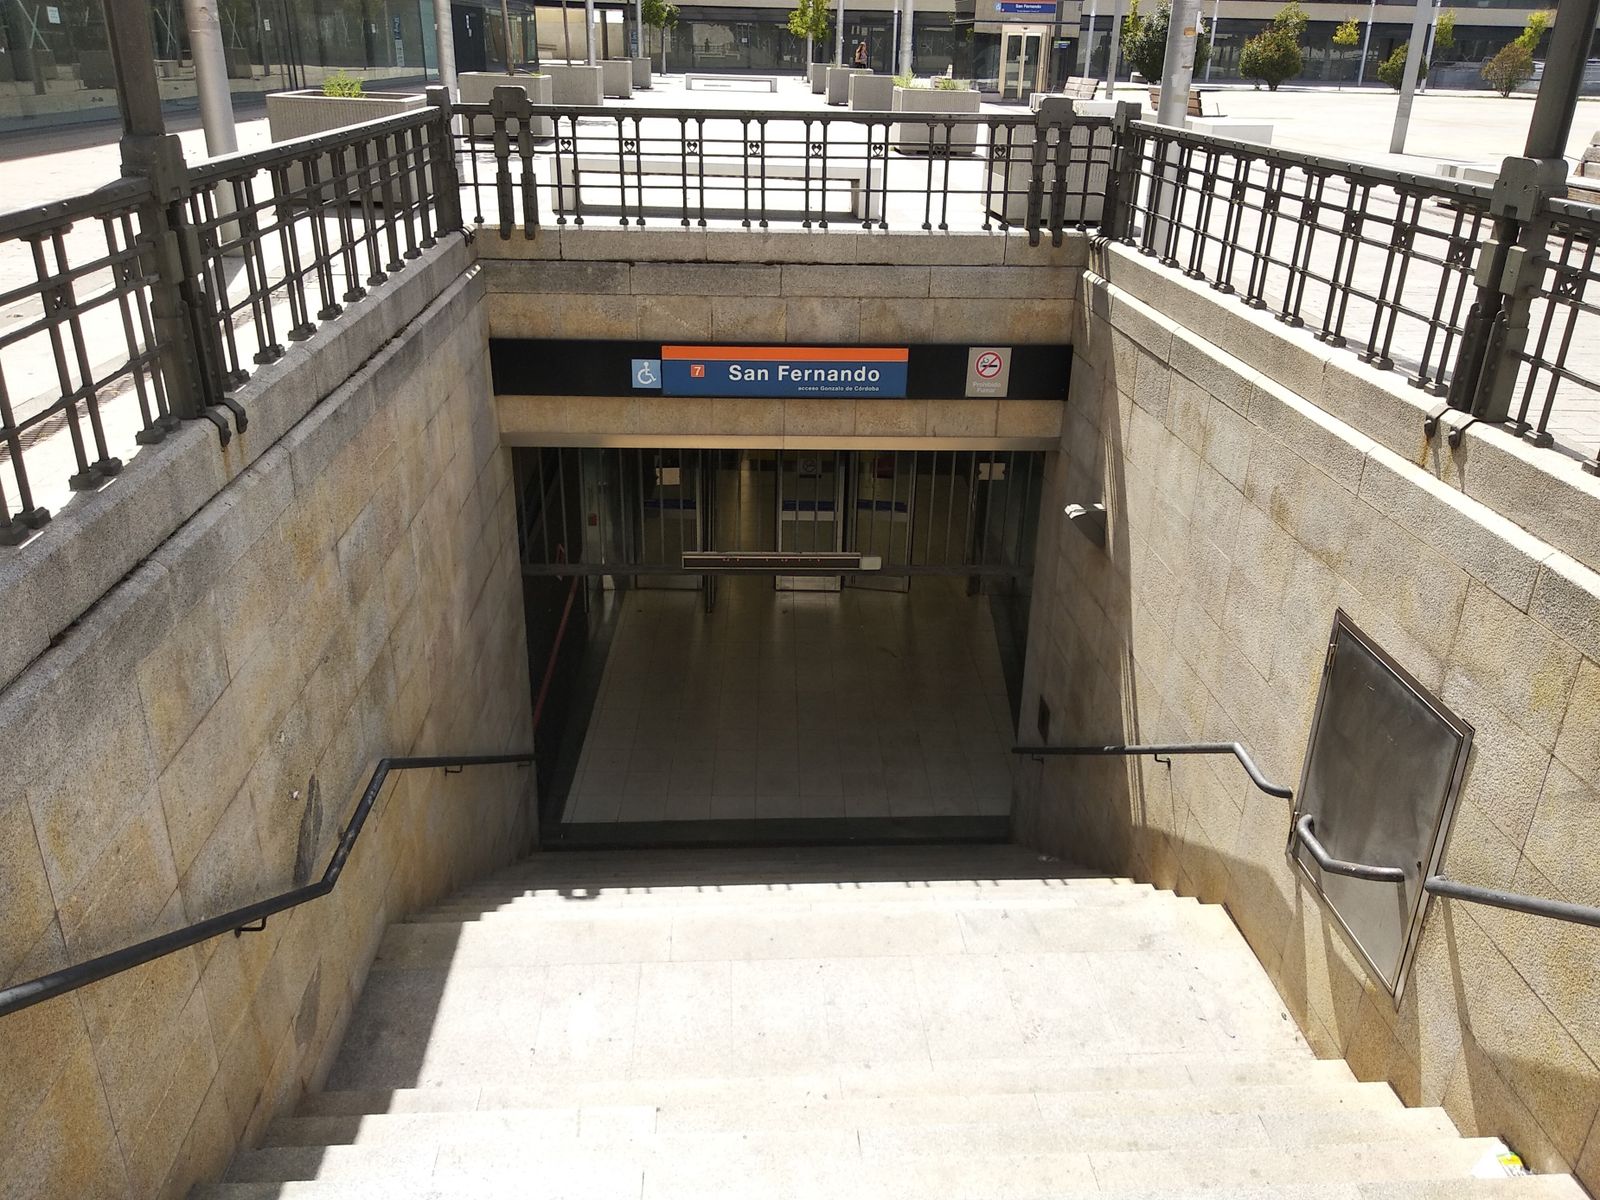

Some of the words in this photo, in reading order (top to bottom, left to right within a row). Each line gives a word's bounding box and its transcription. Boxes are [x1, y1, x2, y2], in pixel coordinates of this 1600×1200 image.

[694, 366, 702, 376] 7
[728, 364, 769, 381] San
[777, 365, 880, 382] Fernando
